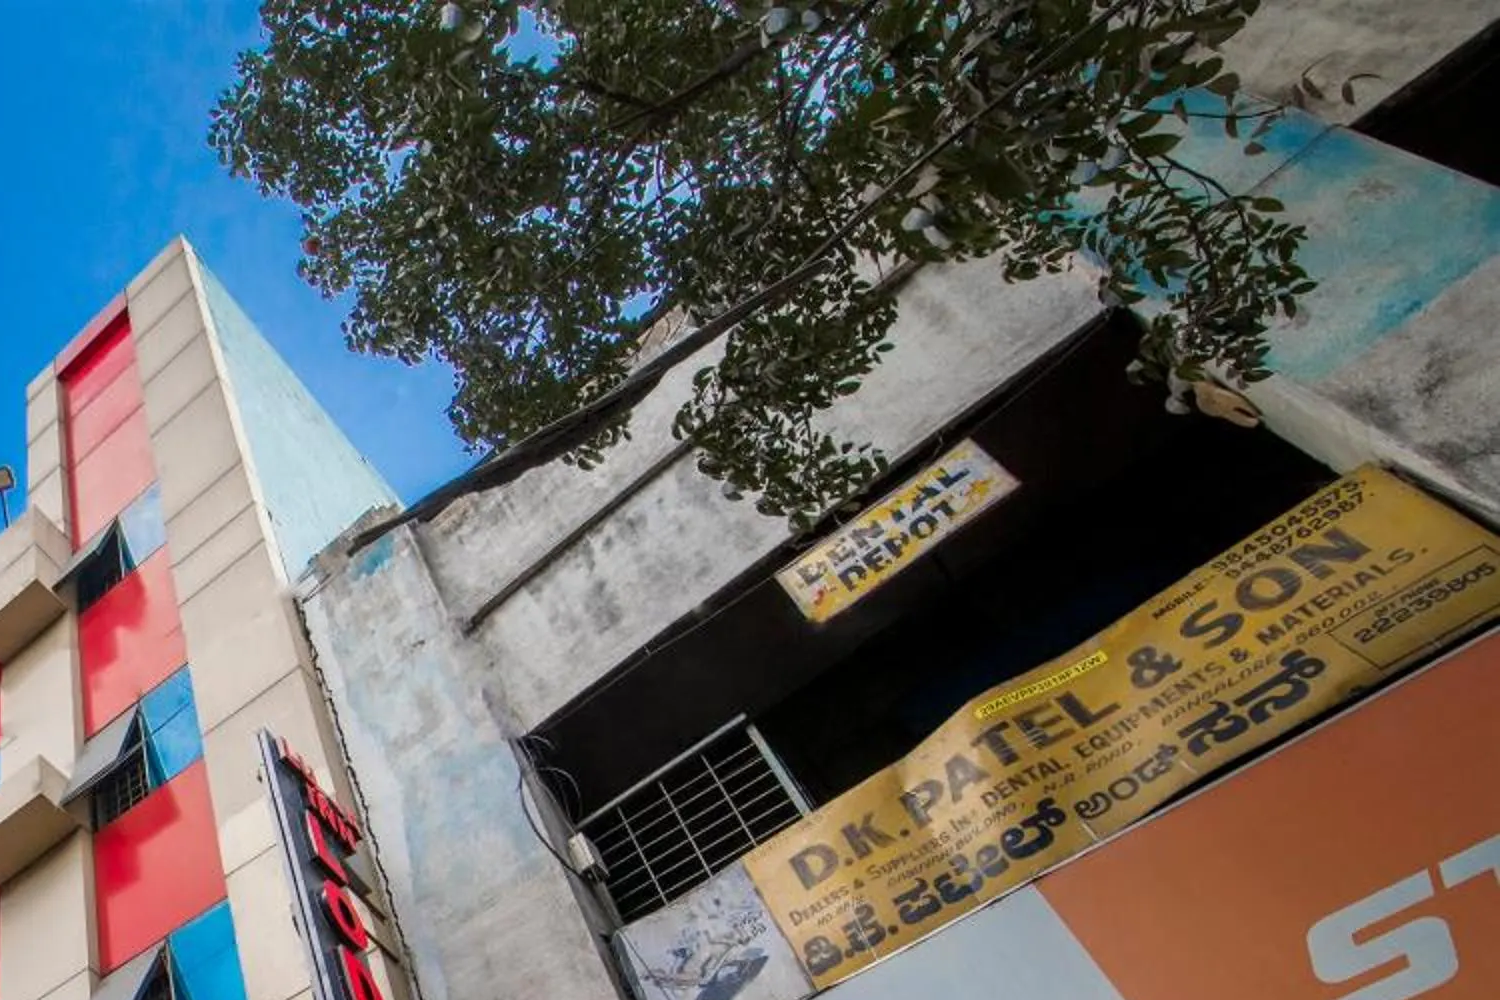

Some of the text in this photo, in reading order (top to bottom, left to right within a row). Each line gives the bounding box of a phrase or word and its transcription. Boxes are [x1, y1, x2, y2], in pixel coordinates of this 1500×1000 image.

[1127, 645, 1184, 690] &
[1180, 526, 1371, 651] SON
[1072, 661, 1228, 758] EQUIPMENTS
[1229, 647, 1250, 664] &
